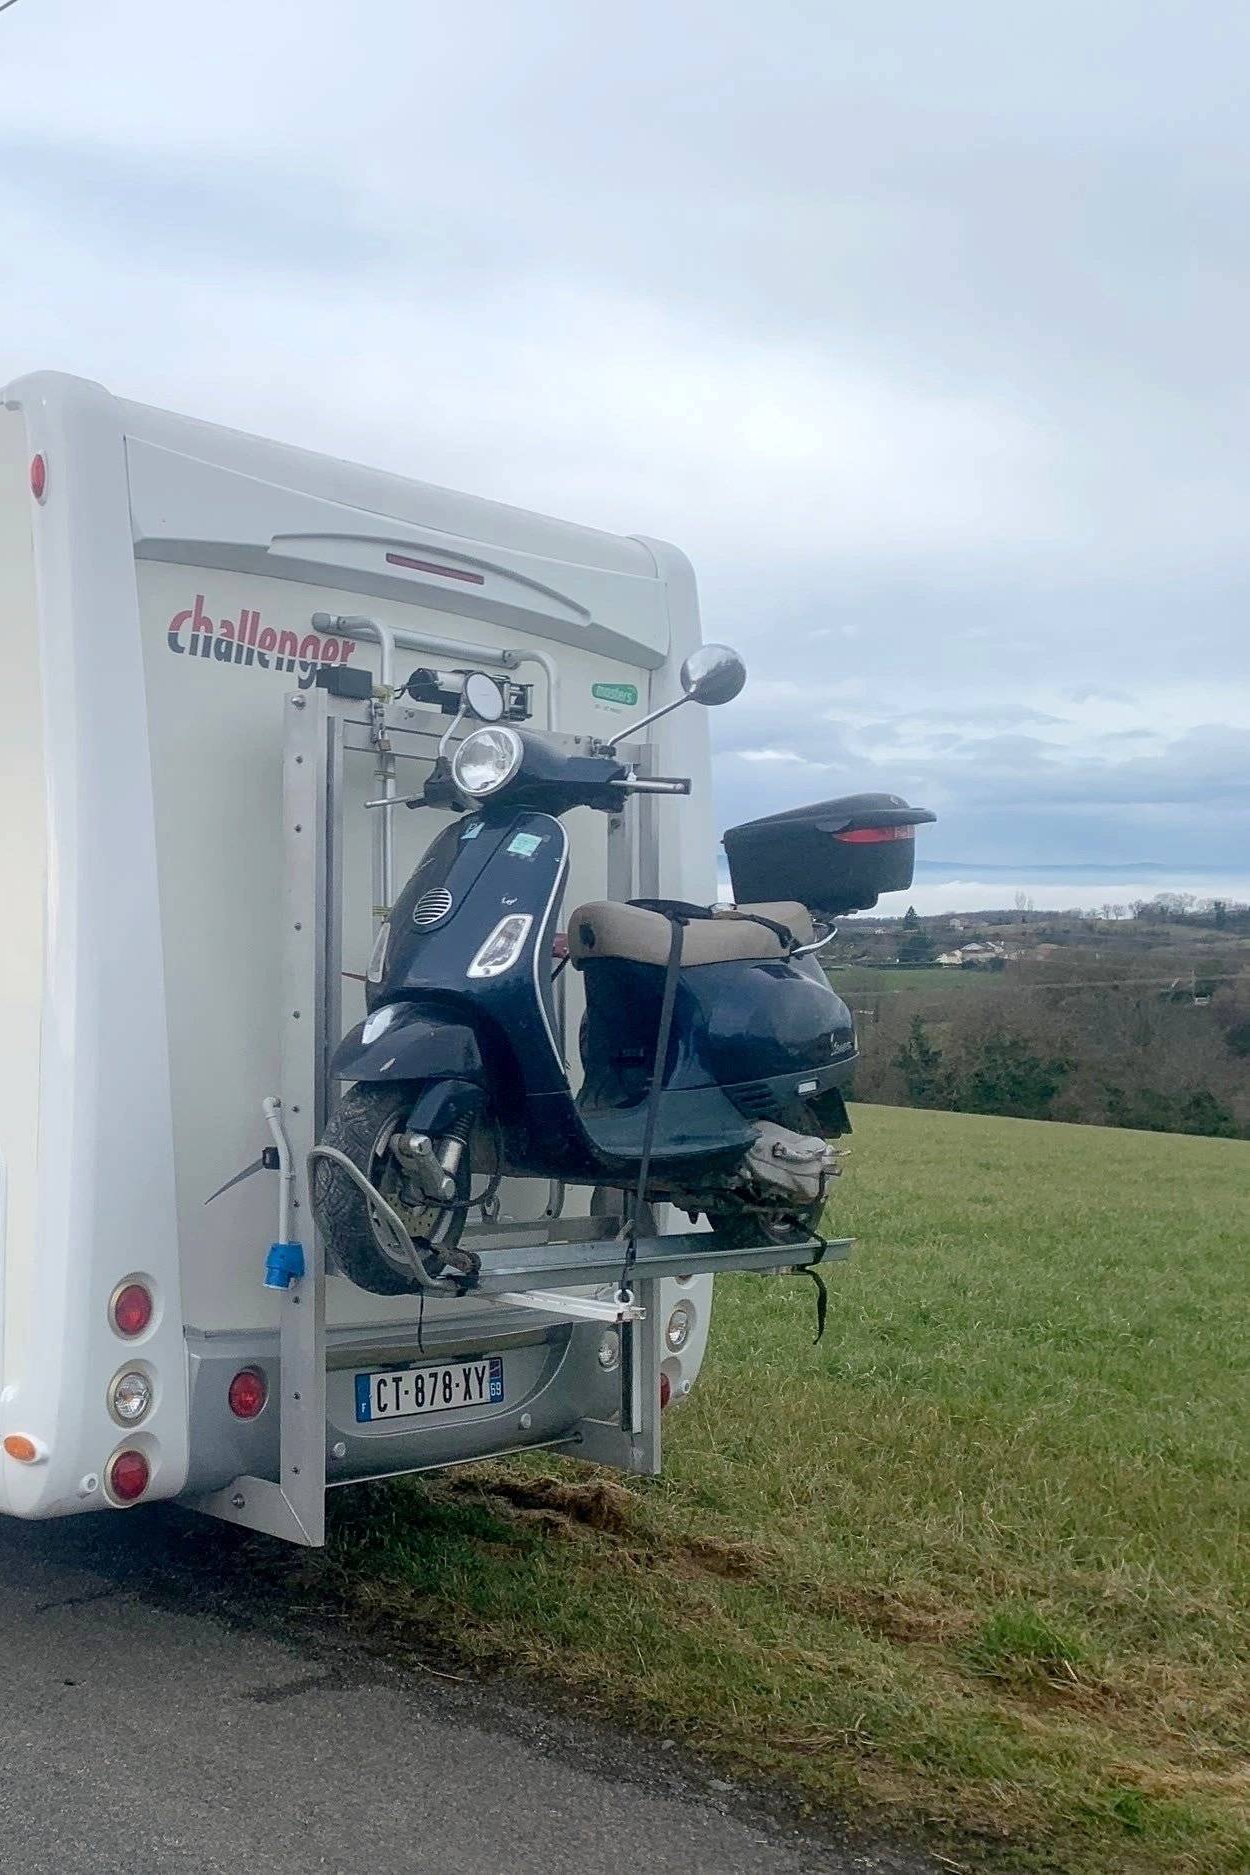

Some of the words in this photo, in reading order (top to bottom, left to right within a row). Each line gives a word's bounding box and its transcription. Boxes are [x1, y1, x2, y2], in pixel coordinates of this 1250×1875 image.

[167, 594, 356, 690] challenger
[376, 1365, 487, 1413] CT-878-XY
[490, 1382, 501, 1396] 69
[361, 1402, 367, 1413] F
